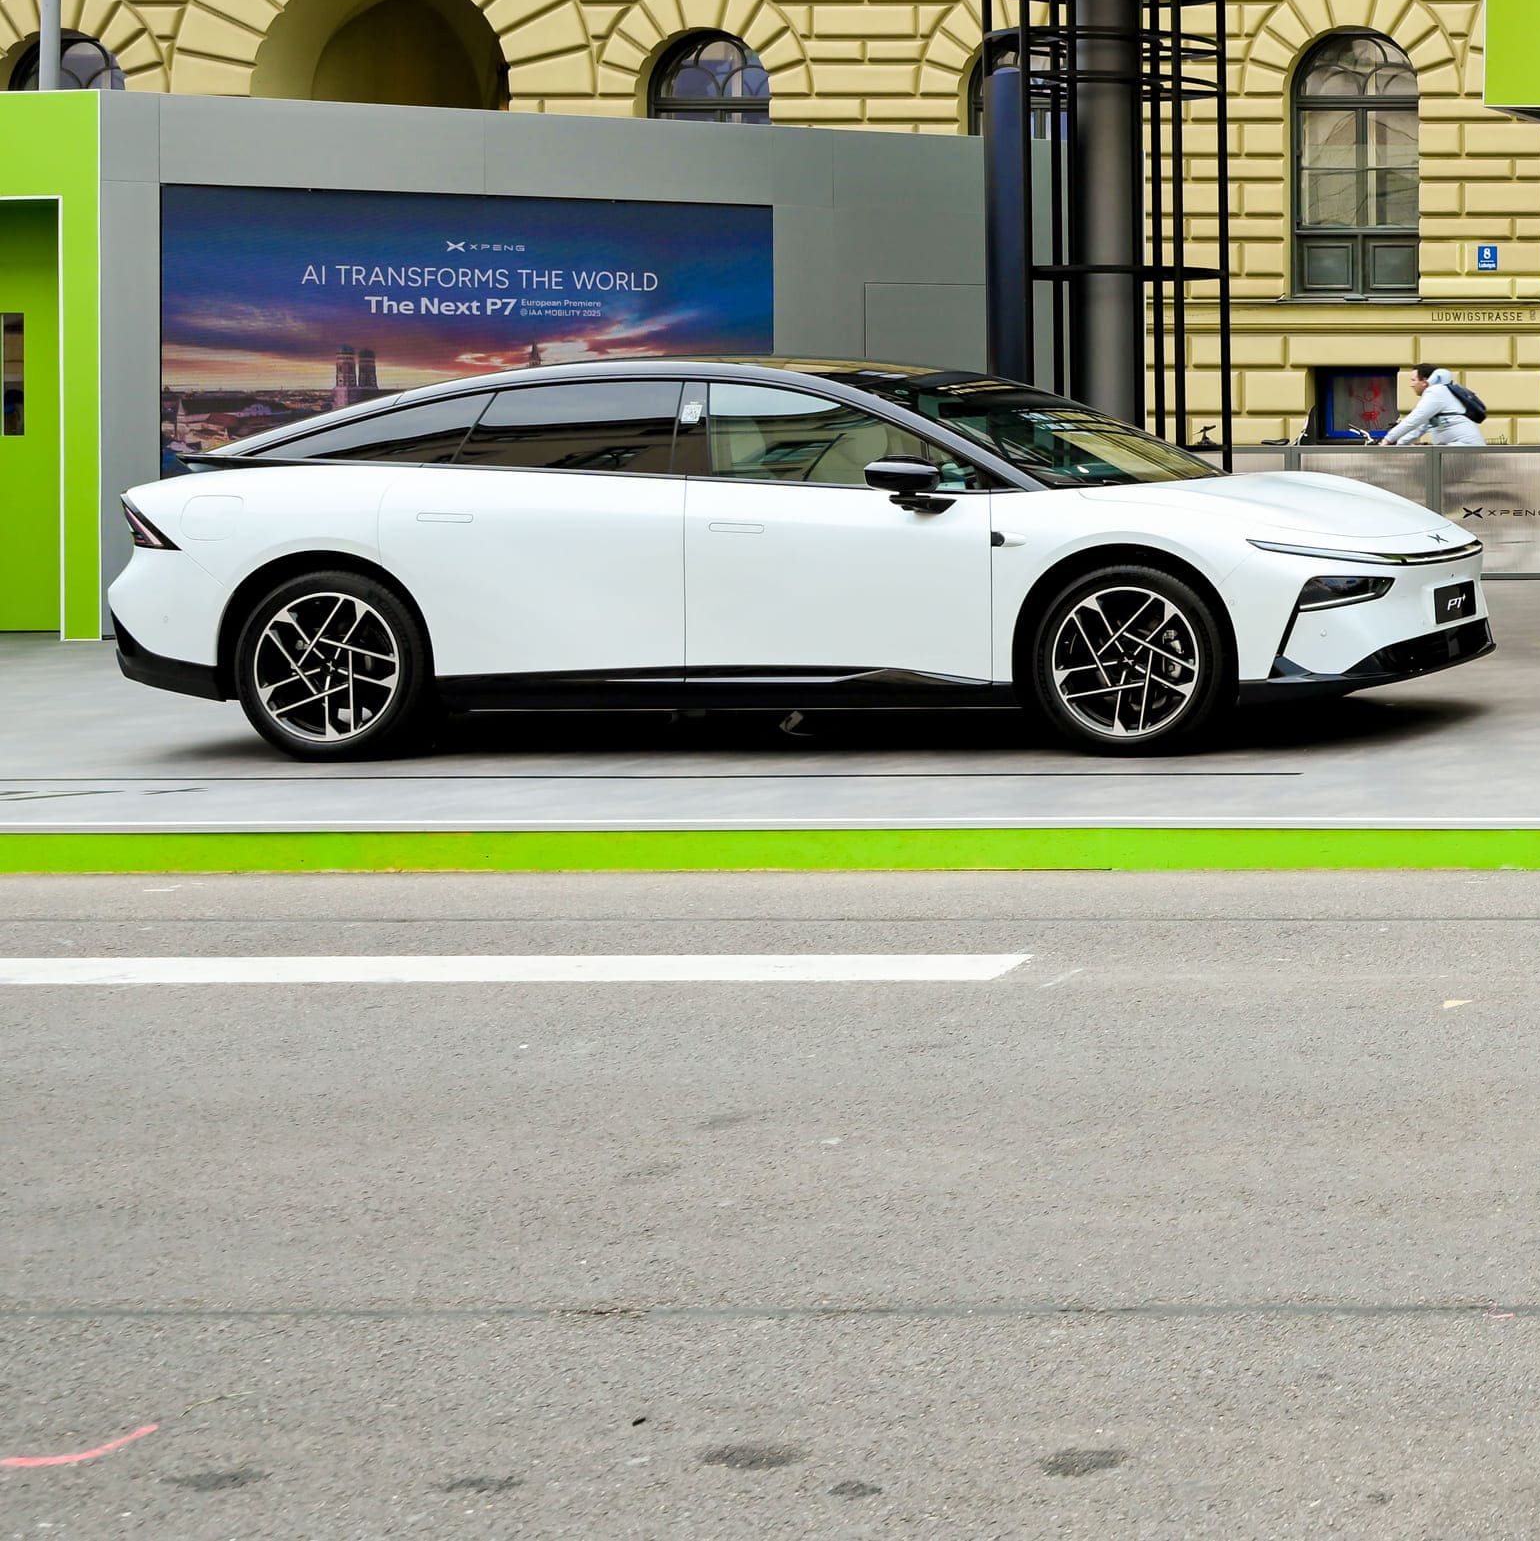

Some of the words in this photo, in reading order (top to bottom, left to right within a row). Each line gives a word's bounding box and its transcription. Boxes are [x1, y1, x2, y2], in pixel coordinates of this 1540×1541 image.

[470, 243, 526, 252] XPENG
[1483, 247, 1492, 260] 8
[301, 264, 326, 285] AI
[335, 265, 510, 289] TRANSFORMS
[517, 269, 564, 290] THE
[572, 271, 659, 292] WORLD
[364, 295, 415, 315] The
[420, 296, 481, 316] Next
[486, 298, 518, 316] P7
[521, 299, 562, 309] European
[564, 299, 602, 308] Premiere
[545, 309, 580, 317] MOBILITY
[1431, 311, 1524, 322] LUDWIGSTRASSE
